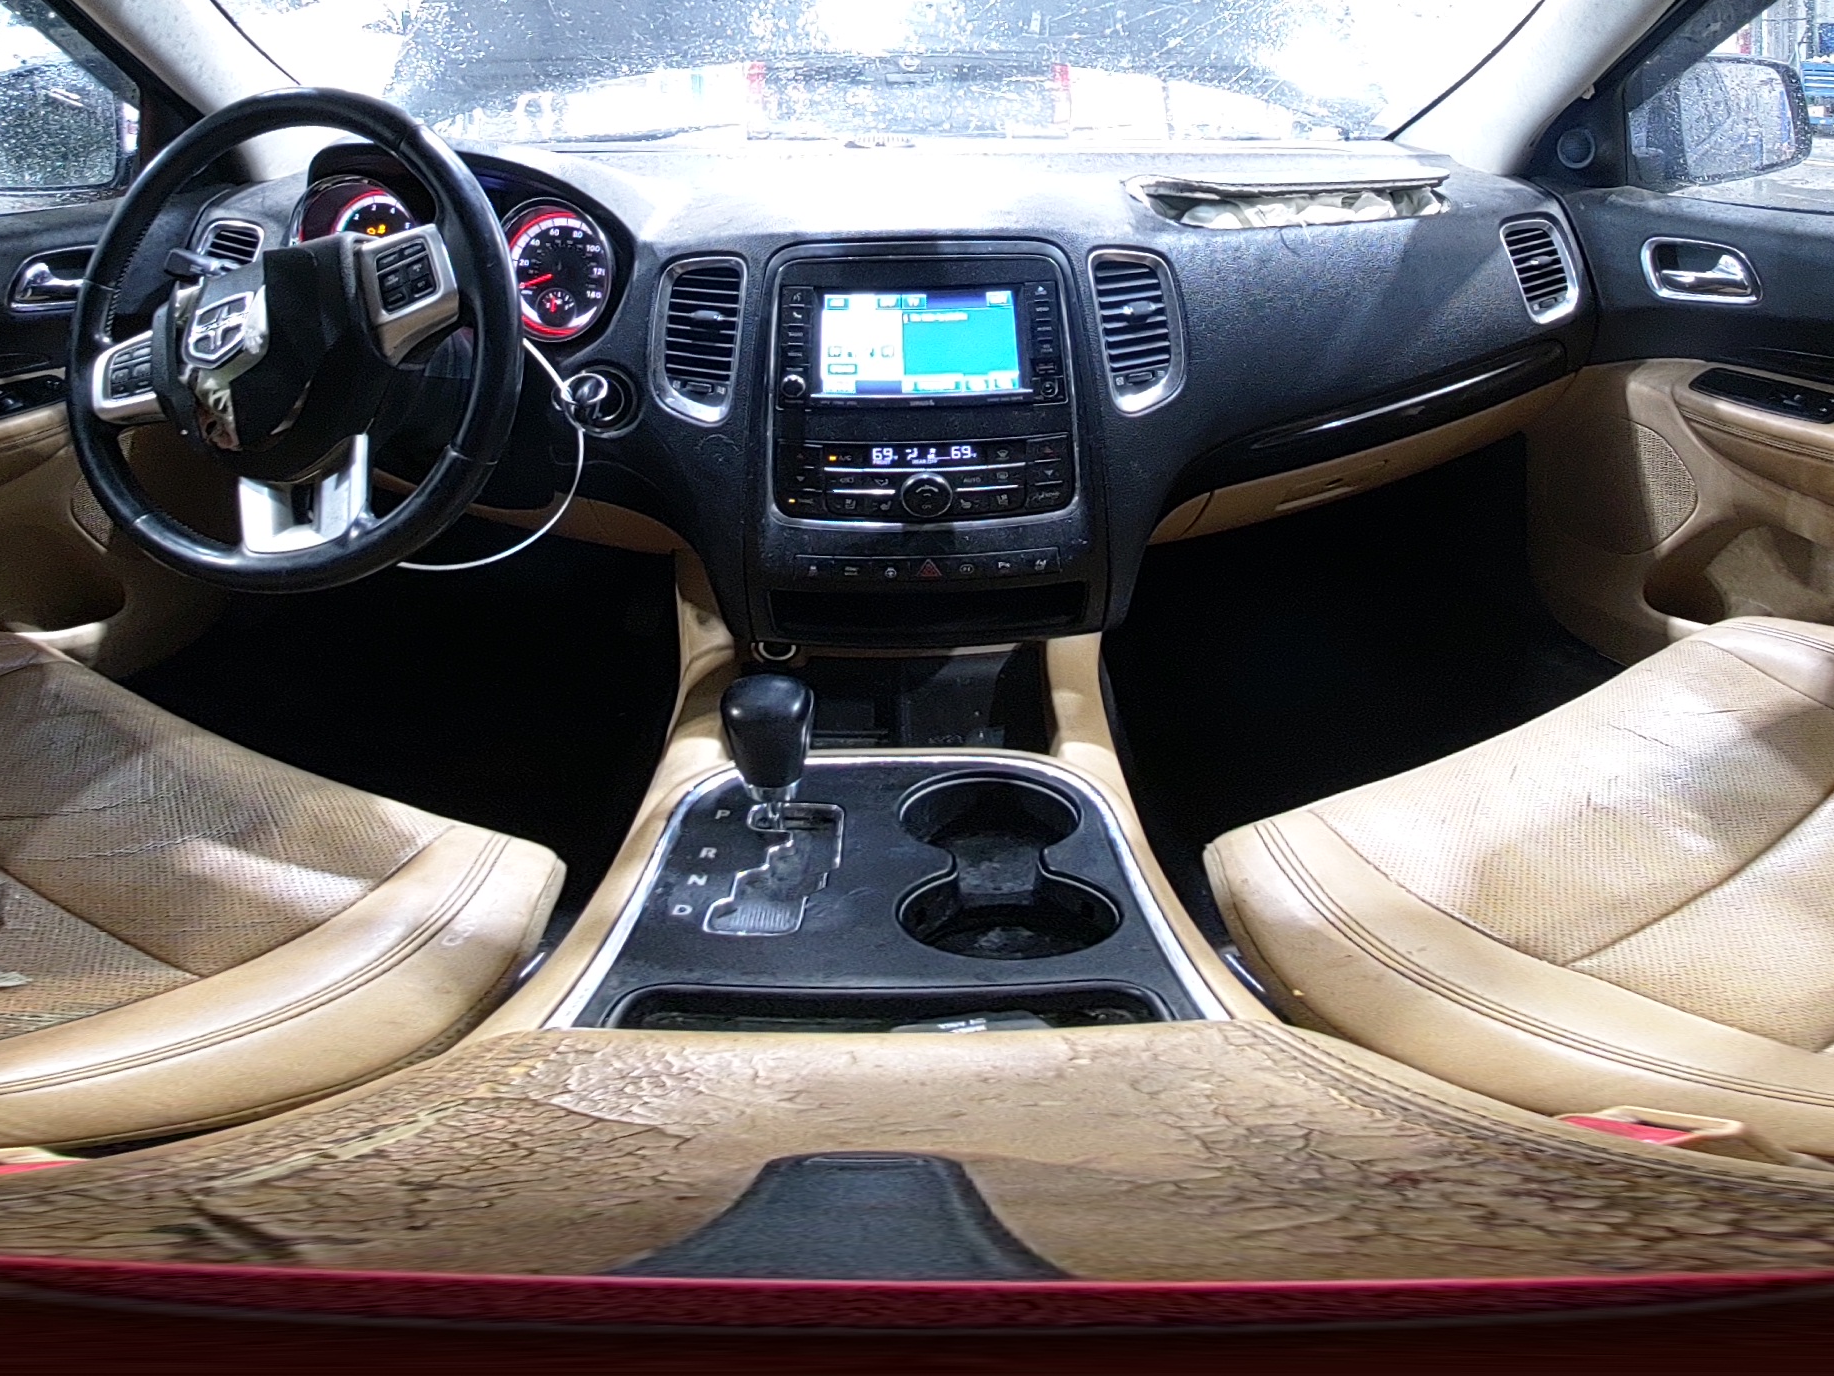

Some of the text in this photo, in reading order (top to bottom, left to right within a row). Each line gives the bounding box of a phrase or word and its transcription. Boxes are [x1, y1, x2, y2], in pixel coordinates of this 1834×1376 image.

[549, 228, 560, 236] 60
[572, 230, 583, 238] 80
[530, 238, 541, 246] 40
[586, 244, 601, 253] 100
[518, 259, 530, 267] 20
[872, 447, 893, 460] 69
[951, 445, 971, 459] 69
[715, 809, 731, 820] P
[699, 847, 718, 858] R
[687, 874, 708, 886] N
[672, 904, 693, 915] D
